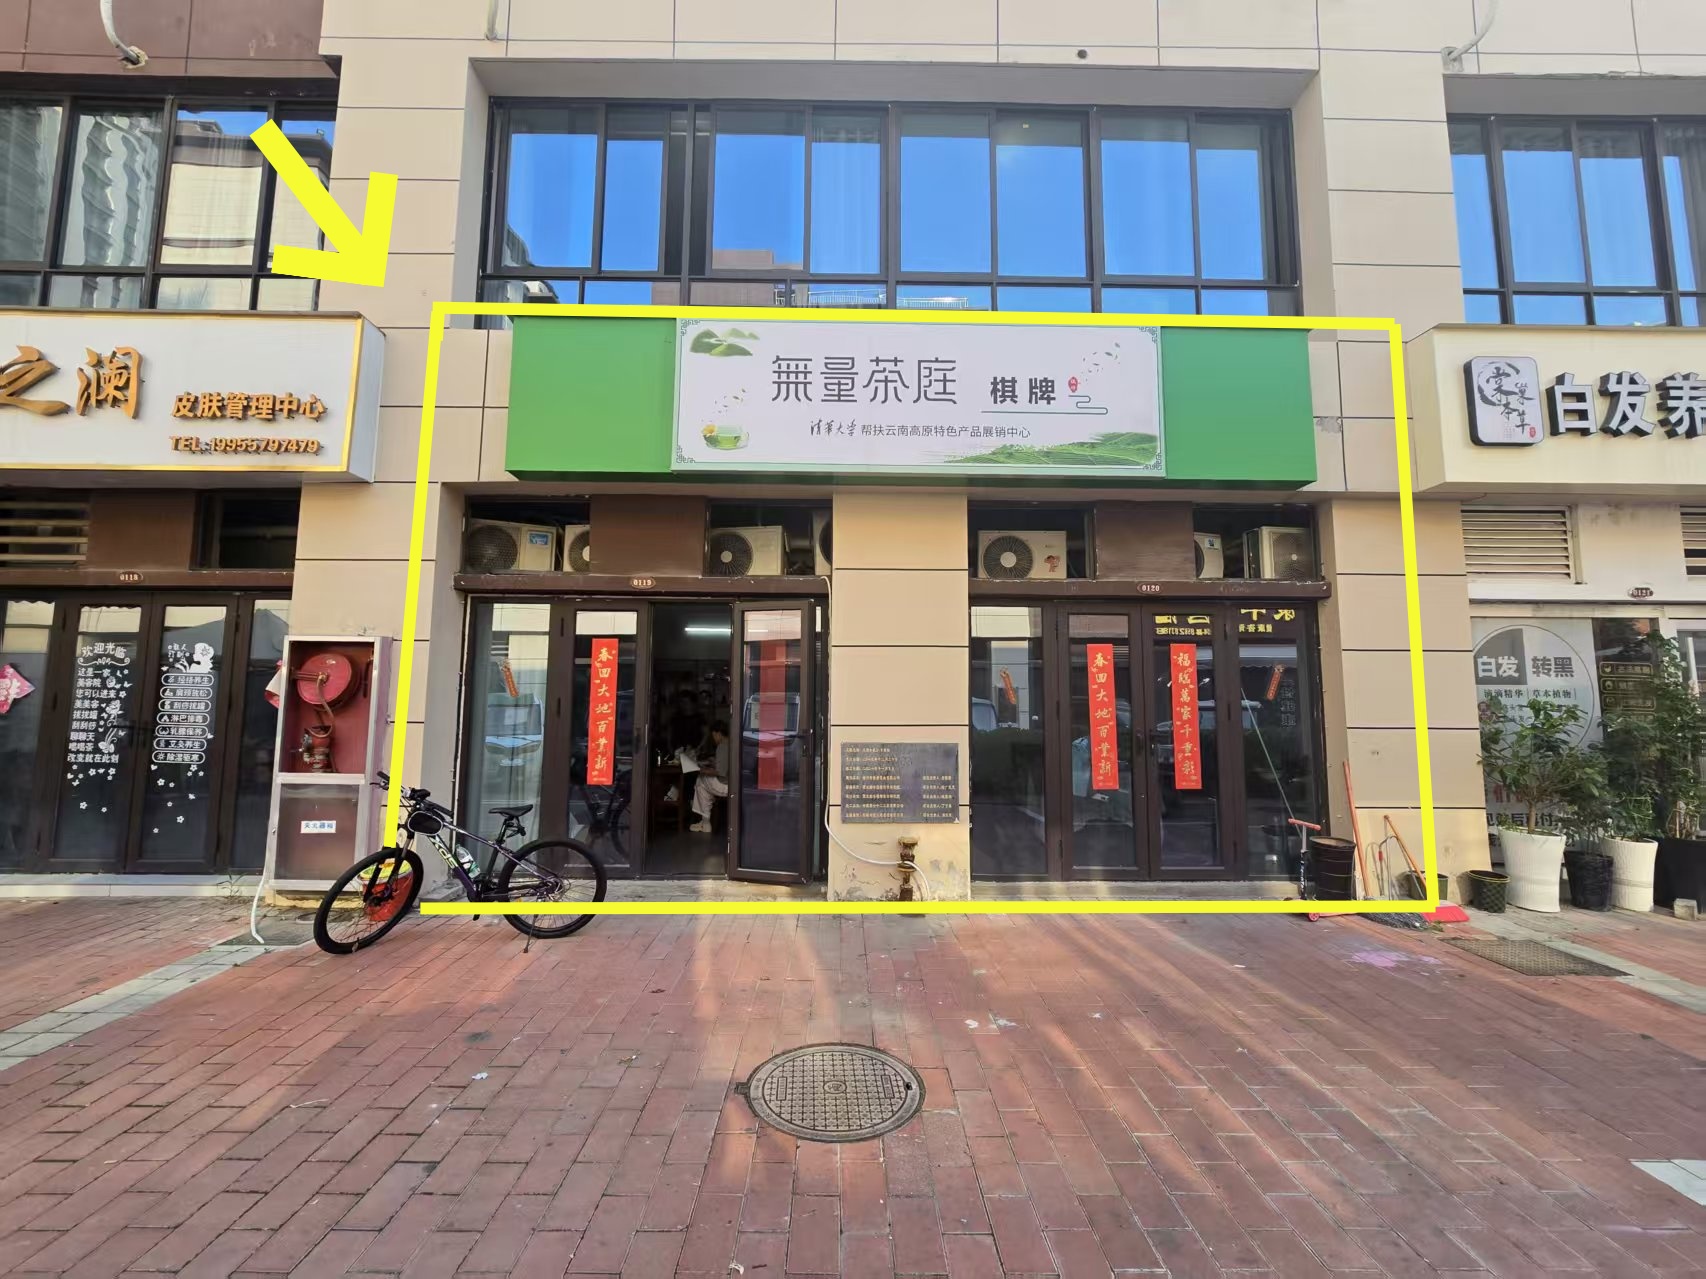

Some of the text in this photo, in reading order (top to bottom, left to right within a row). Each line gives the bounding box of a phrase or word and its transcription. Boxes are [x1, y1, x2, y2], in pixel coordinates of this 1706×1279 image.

[990, 376, 1056, 405] 棋牌
[171, 392, 327, 421] 皮肤管理中心
[861, 424, 1031, 438] 帮扶云南高原特色产品展销中心
[119, 573, 138, 581] 0118
[1141, 584, 1160, 592] 0120
[1632, 588, 1650, 597] 0121
[81, 642, 127, 659] 欢迎光临
[1477, 655, 1574, 678] 白发 转黑
